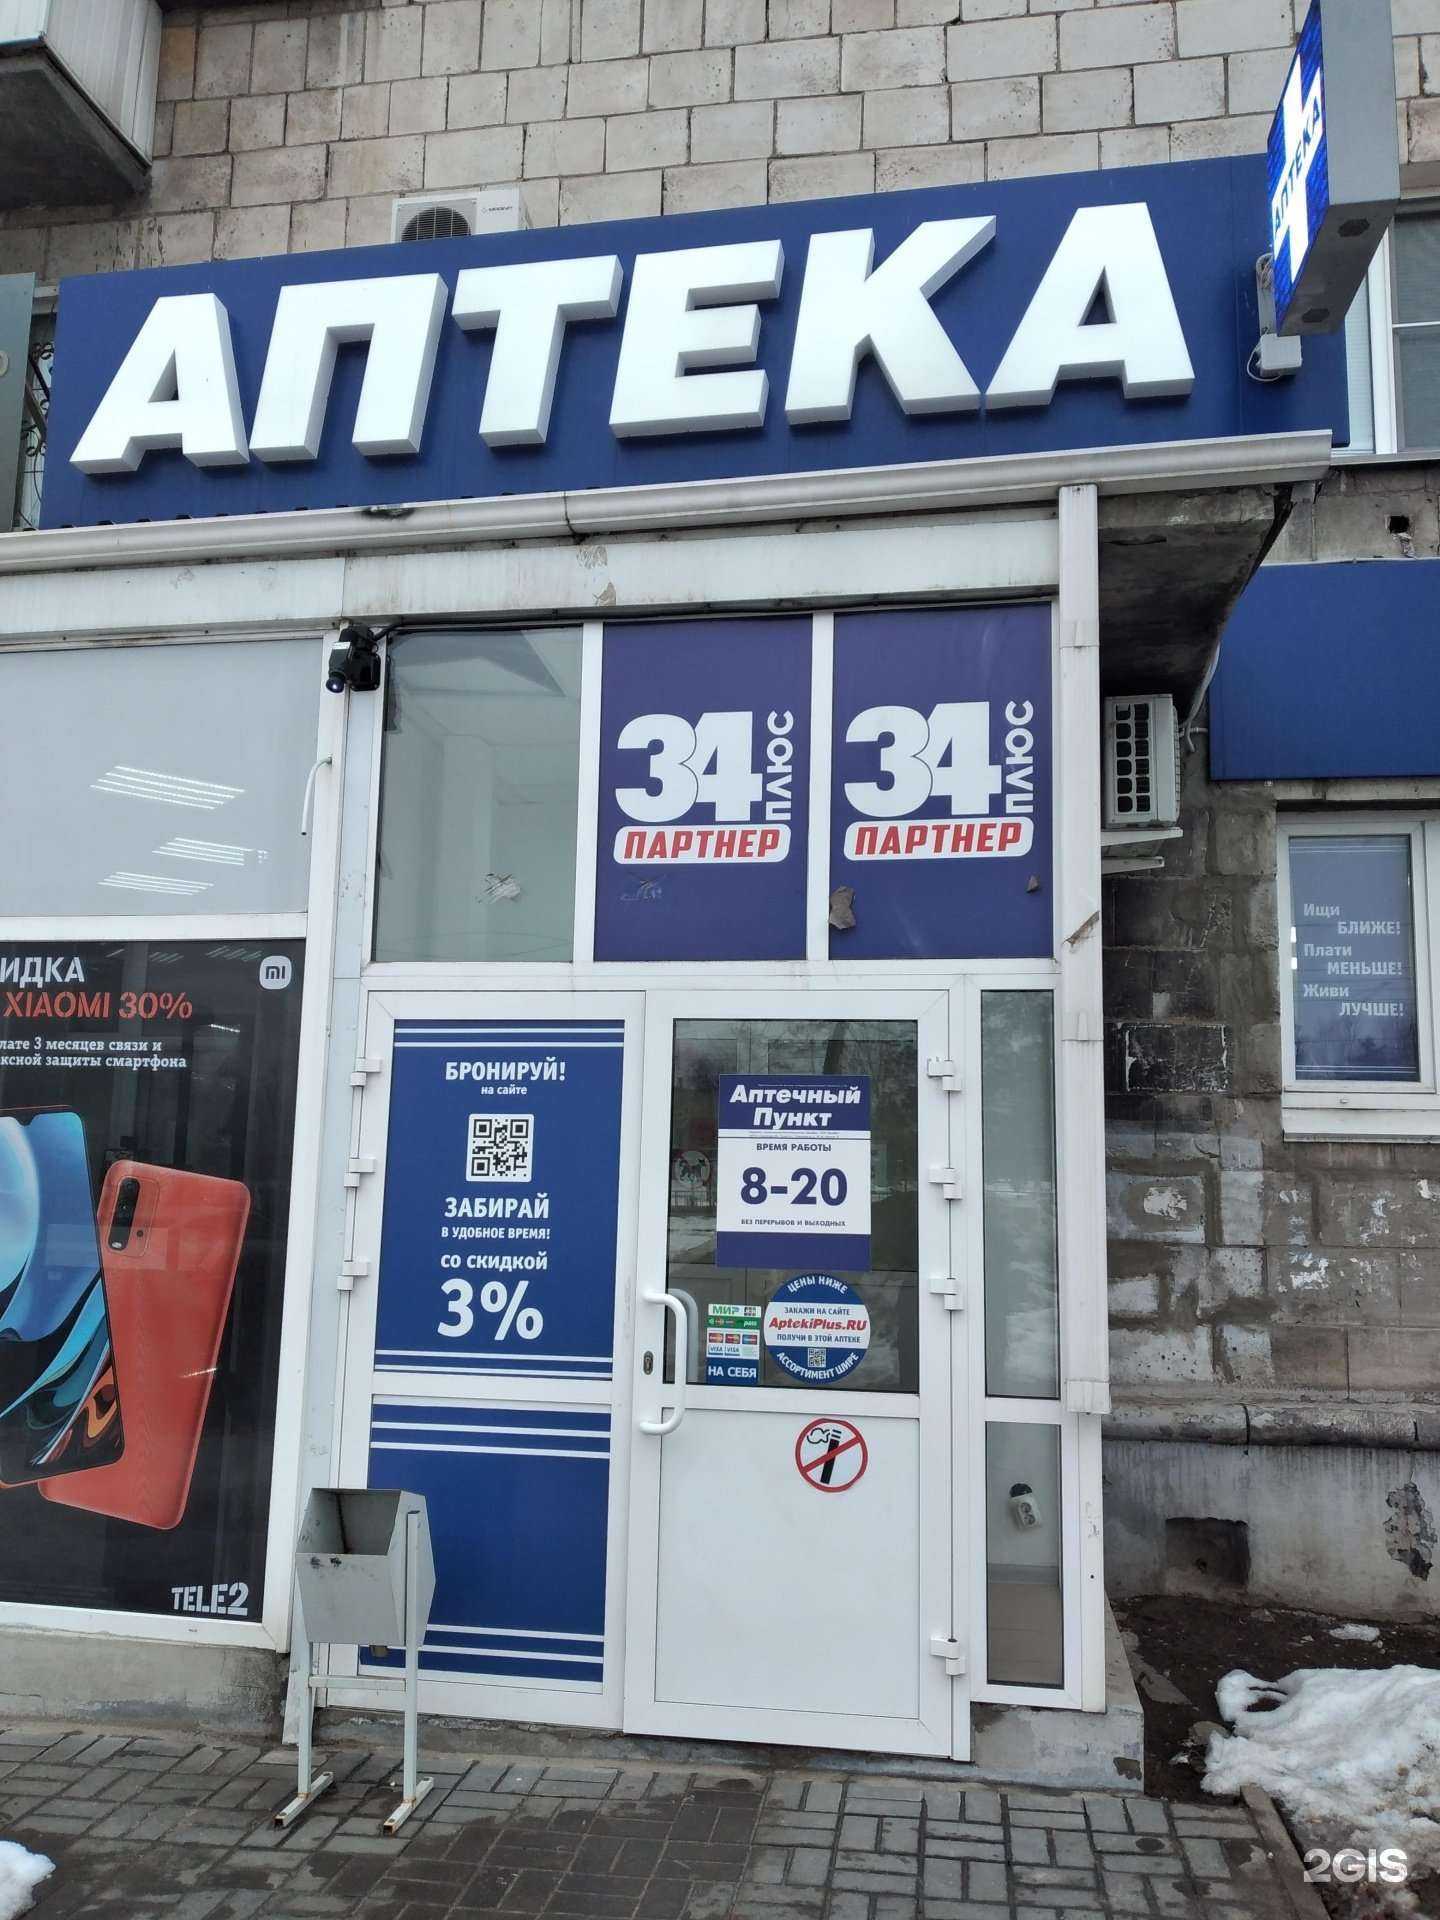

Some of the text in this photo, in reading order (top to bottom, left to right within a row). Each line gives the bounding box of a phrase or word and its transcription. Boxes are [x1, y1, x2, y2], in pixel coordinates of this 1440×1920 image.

[1275, 95, 1321, 235] АПТЕКА
[69, 202, 1195, 475] АПТЕКА
[615, 711, 763, 822] 34
[765, 710, 794, 820] ПЛЮС
[843, 701, 1002, 817] 34
[1004, 700, 1034, 813] ПЛЮС
[624, 829, 780, 859] ПАРТНЕР
[854, 822, 1023, 855] ПАРТНЕР
[1303, 904, 1340, 918] Ищи
[1337, 921, 1401, 935] БЛИЖЕ!
[1303, 944, 1352, 957] Плати
[1327, 961, 1402, 976] МЕНЬШЕ!
[1303, 984, 1350, 998] Живи
[3, 992, 193, 1019] XIAOMI 30%
[1339, 1001, 1404, 1016] ЛУЧШЕ!
[34, 1036, 42, 1050] 3
[46, 1039, 104, 1052] месяцев
[108, 1040, 148, 1051] связи
[152, 1041, 162, 1051] и
[45, 1056, 102, 1068] защиты
[105, 1056, 187, 1071] смартфона
[445, 1057, 566, 1081] БРОНИРУЙ!
[481, 1083, 528, 1095] на сайте
[730, 1084, 861, 1104] Аптечный
[753, 1107, 832, 1130] Пункт
[756, 1143, 832, 1152] ВРЕМЯ РАБОТЫ
[741, 1167, 847, 1206] 8-20
[444, 1193, 550, 1218] ЗАБИРАЙ
[452, 1226, 505, 1240] УДОБНОЕ
[508, 1228, 551, 1239] ВРЕМЯ!
[787, 1275, 848, 1294] ЦЕНЫ НИЖЕ
[437, 1278, 544, 1341] 3%
[828, 1307, 850, 1315] САЙТЕ
[769, 1317, 867, 1331] AptekiPlus.RU
[777, 1334, 806, 1342] ПОЛУЧИ
[815, 1334, 832, 1342] ЭТОЙ
[708, 1366, 757, 1378] НА СЕБЯ
[777, 1352, 859, 1380] АССОРТИМЕНТ ШИРЕ
[171, 1582, 249, 1616] TELE2
